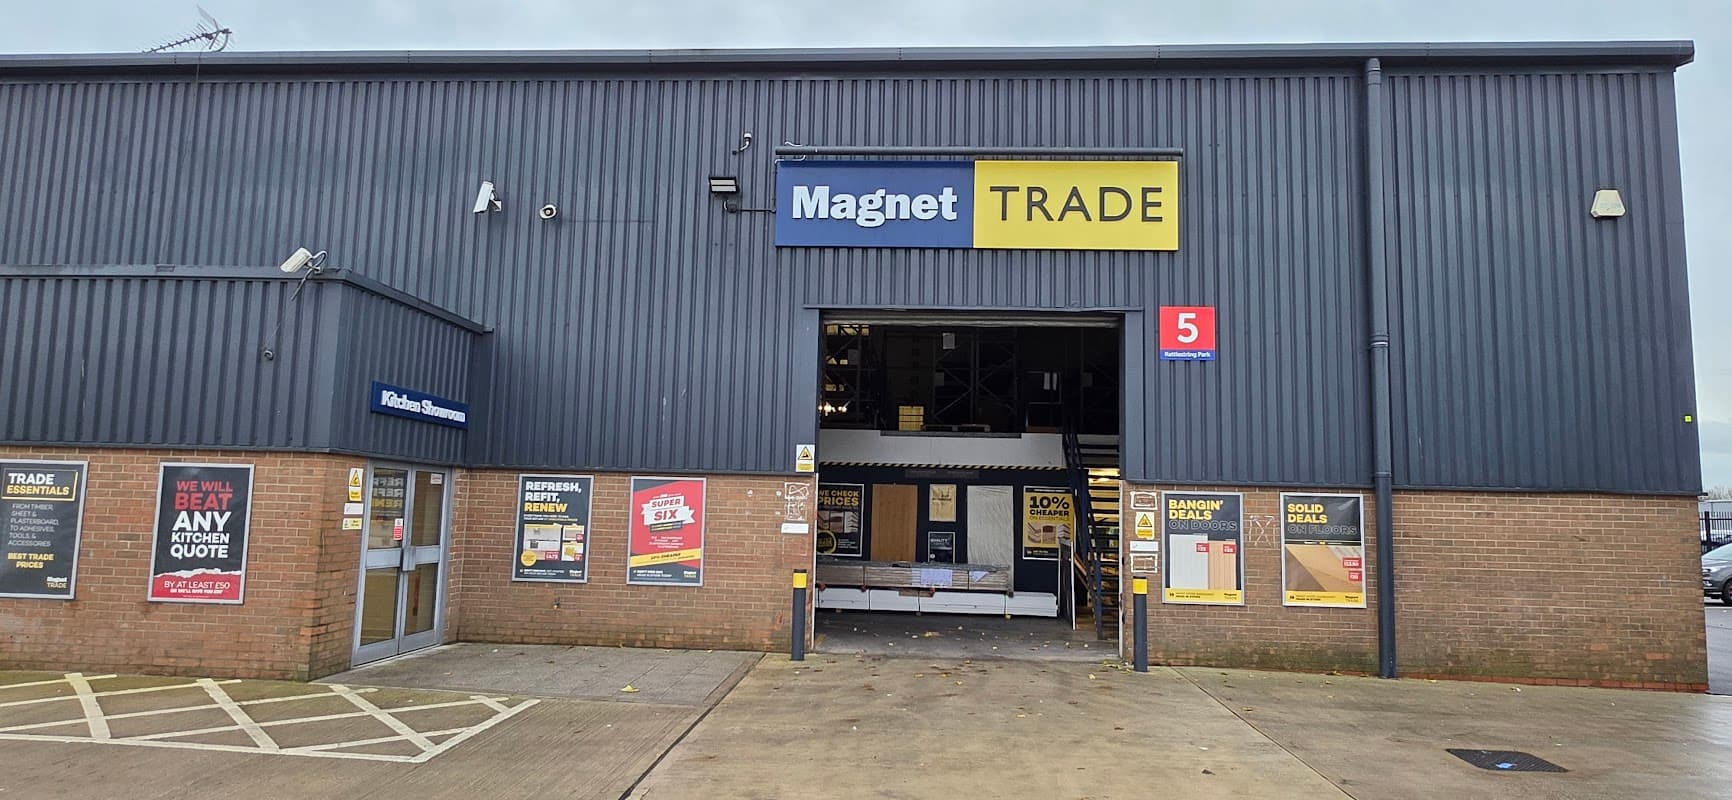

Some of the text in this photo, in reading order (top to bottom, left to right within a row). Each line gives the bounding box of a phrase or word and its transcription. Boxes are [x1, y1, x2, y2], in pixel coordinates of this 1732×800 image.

[792, 185, 959, 228] Magnet
[989, 185, 1163, 223] TRADE
[1176, 312, 1199, 344] 5
[380, 390, 466, 423] Kitchen Showroom
[8, 472, 56, 485] TRADE
[6, 485, 70, 496] ESSENTIALS
[176, 480, 233, 492] WE WILL
[526, 481, 582, 493] REFRESH,
[174, 492, 233, 510] BEAT
[525, 492, 560, 503] REFIT,
[652, 498, 681, 508] SUPER
[819, 497, 860, 506] PRICES
[1030, 496, 1070, 509] 10%
[524, 502, 568, 513] RENEW
[1168, 499, 1224, 510] BANGIN'
[1288, 503, 1324, 513] SOLID
[654, 509, 678, 521] SIX
[1169, 510, 1212, 520] DEALS
[1288, 514, 1328, 524] DEALS
[172, 511, 232, 532] ANY
[1169, 520, 1237, 530] ON DOORS
[1288, 525, 1357, 535] ON FLOORS
[171, 532, 230, 544] KITCHEN
[170, 544, 228, 560] QUOTE
